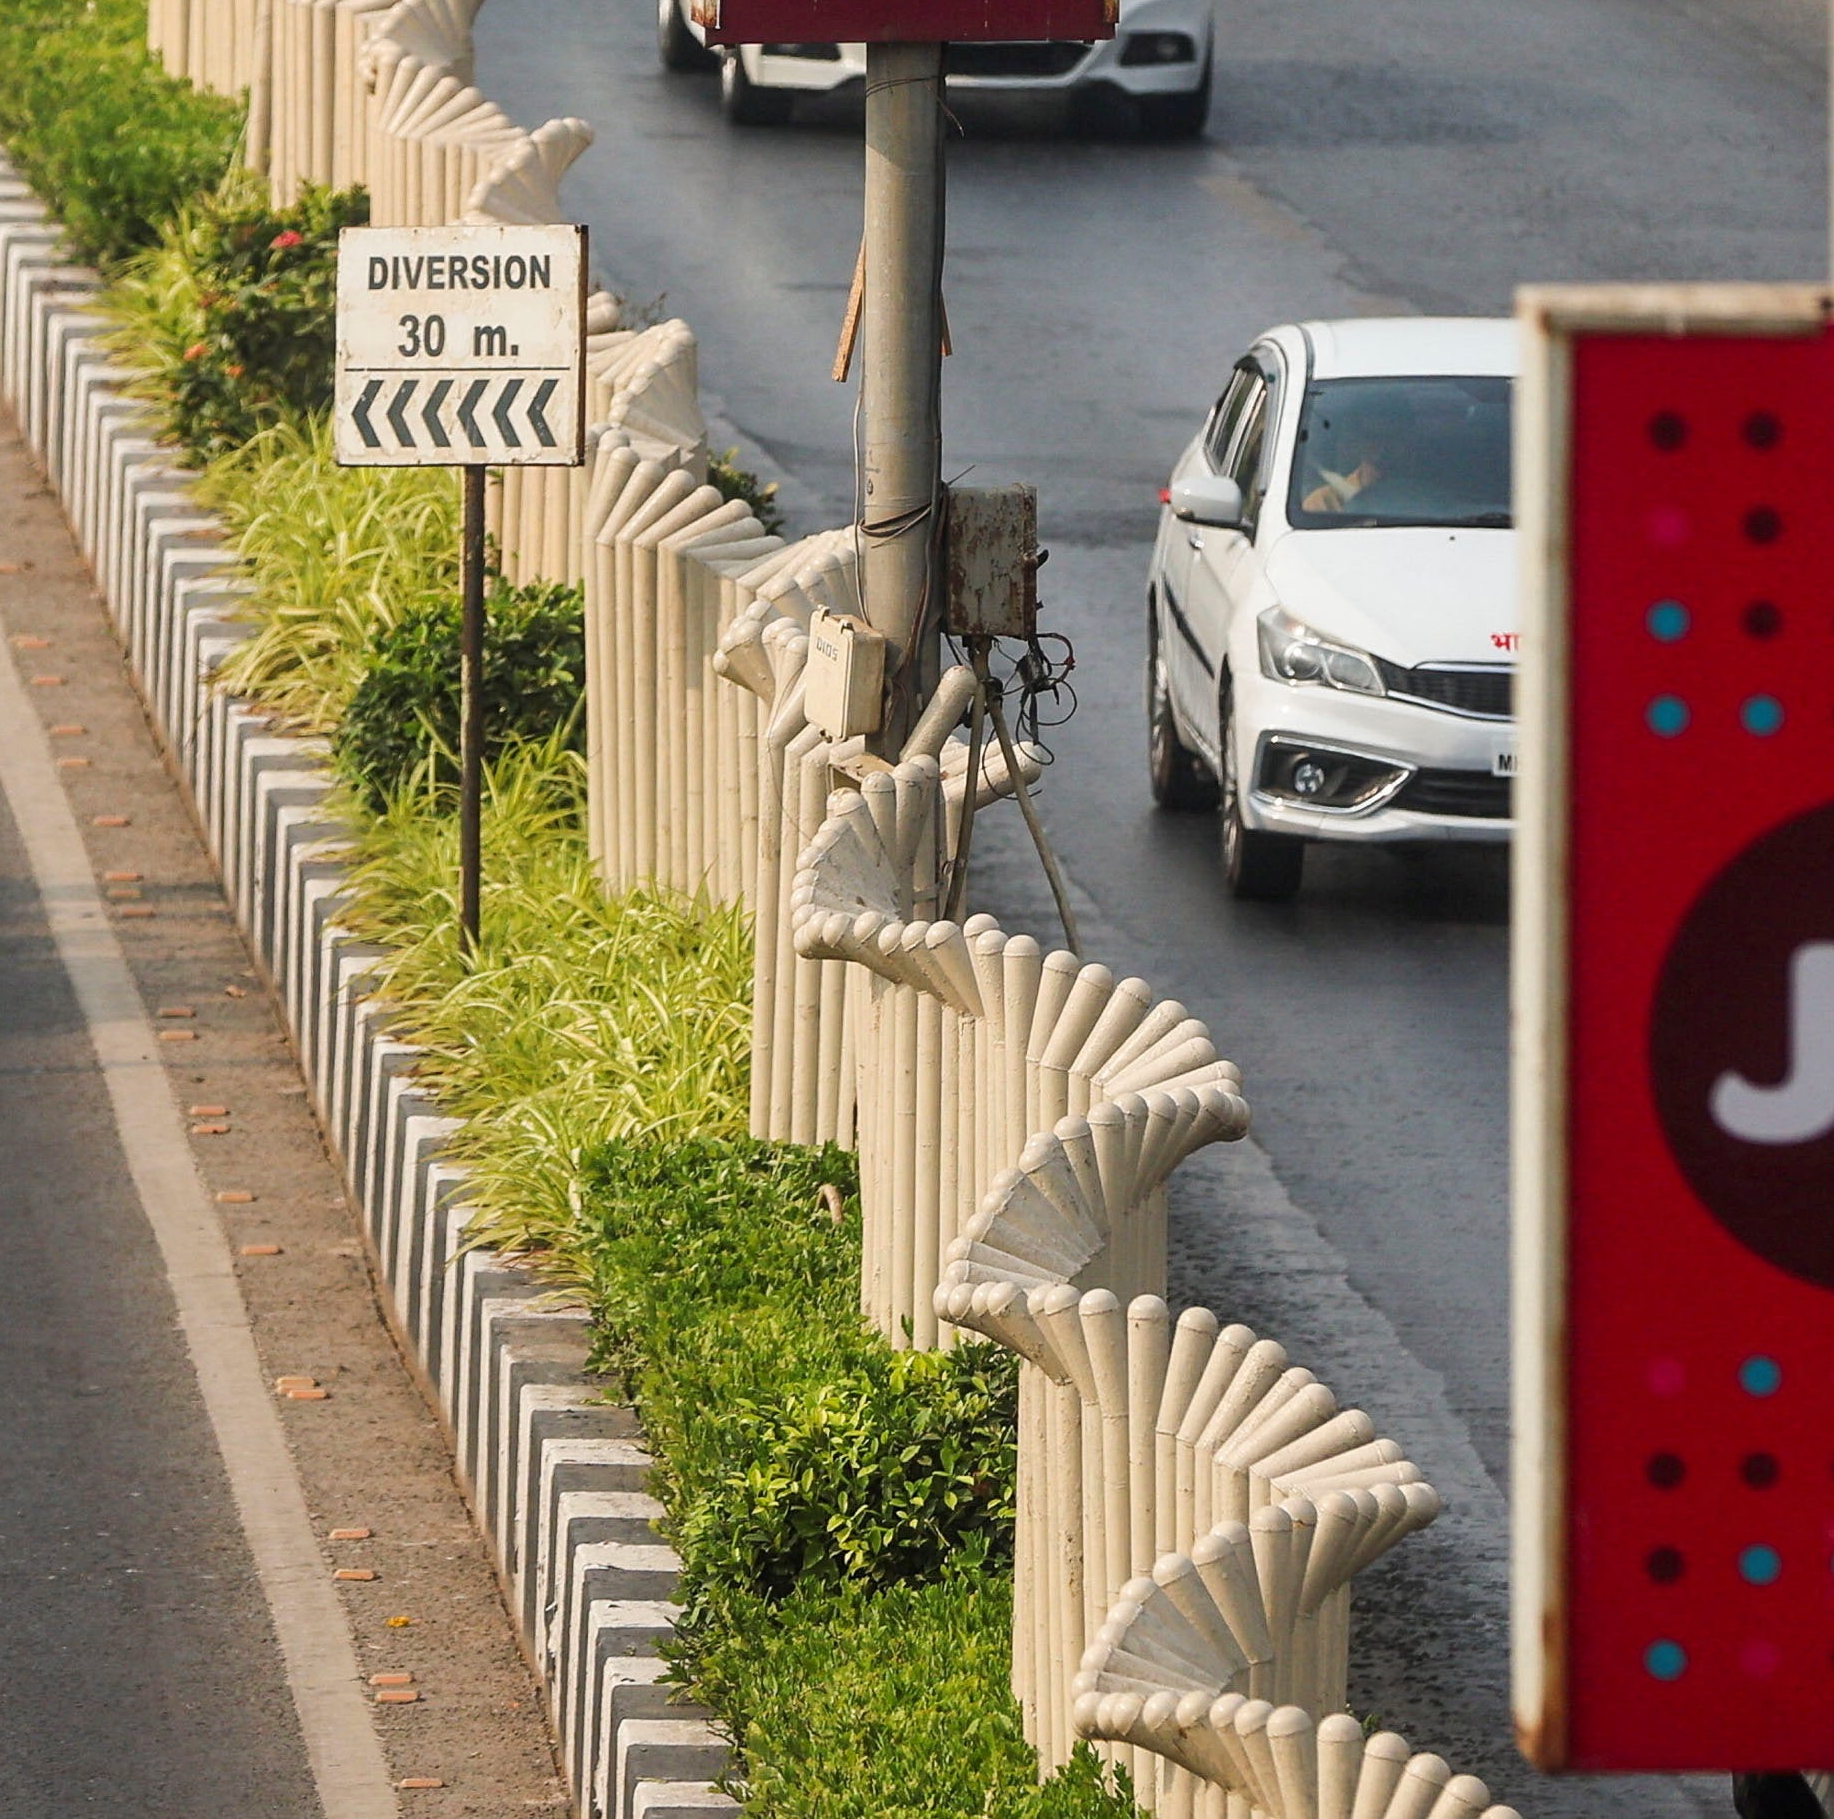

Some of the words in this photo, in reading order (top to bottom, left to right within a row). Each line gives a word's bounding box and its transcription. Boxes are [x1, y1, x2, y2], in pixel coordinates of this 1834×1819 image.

[367, 254, 551, 291] DIVERSION
[397, 313, 445, 358] 30
[472, 324, 520, 358] m.
